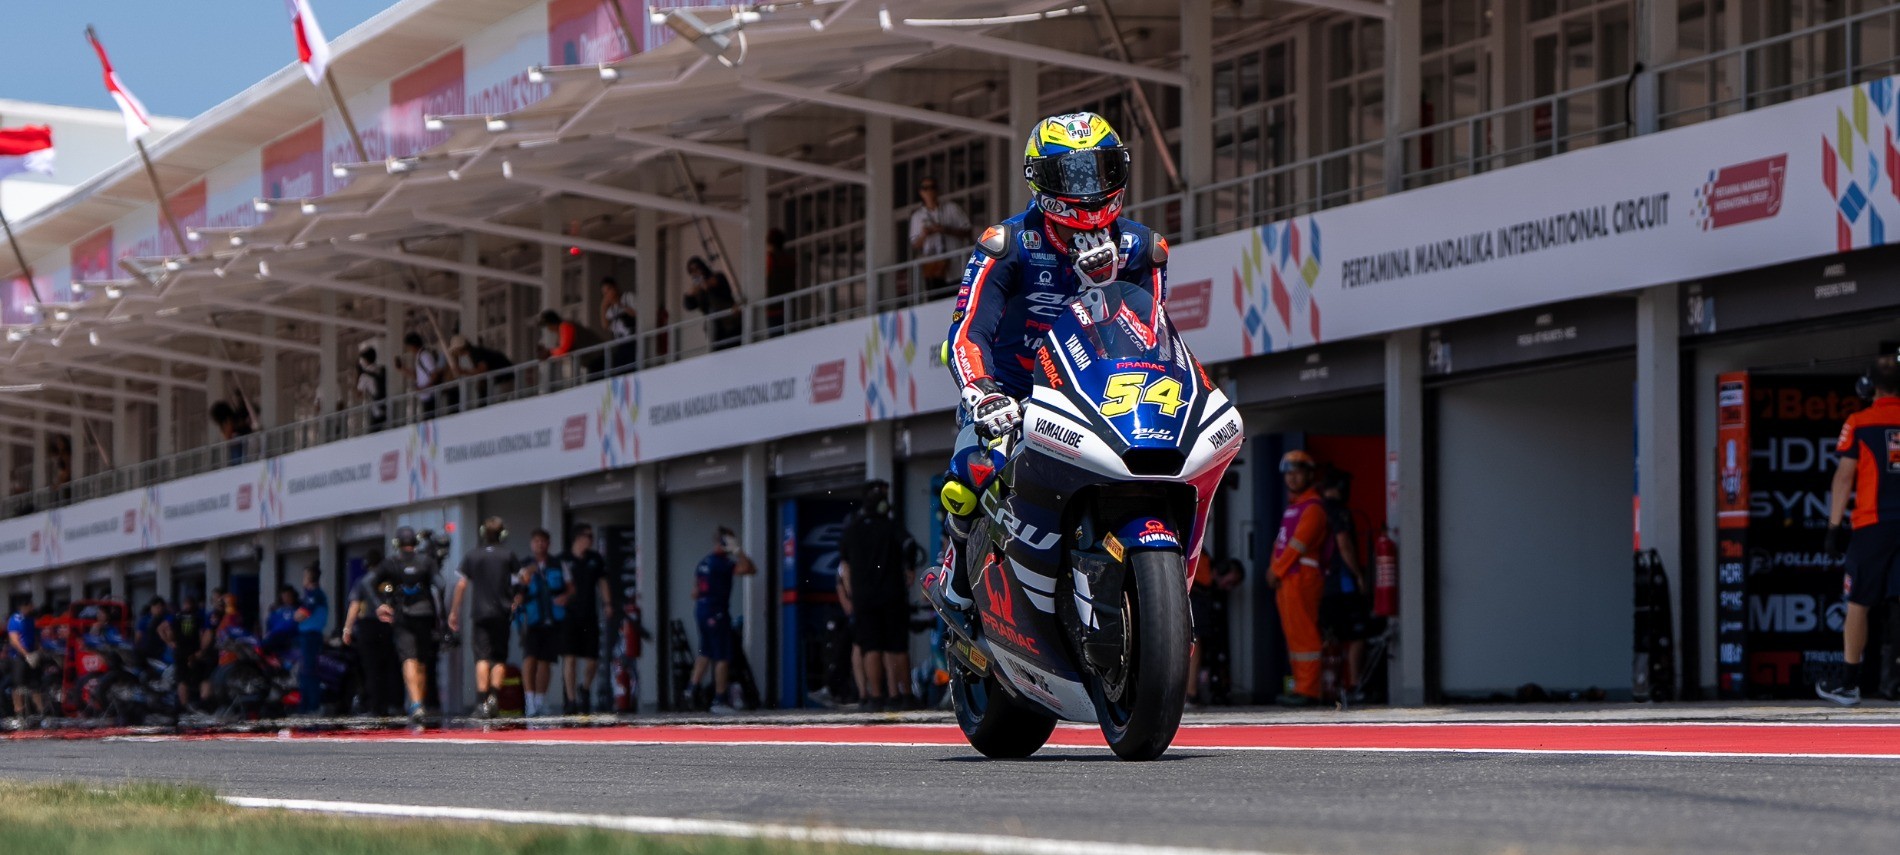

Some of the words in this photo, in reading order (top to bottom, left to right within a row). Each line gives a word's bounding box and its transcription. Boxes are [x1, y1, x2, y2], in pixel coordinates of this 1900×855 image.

[1341, 248, 1412, 290] PERTAMINA
[1413, 229, 1495, 276] MANDALIKA
[1497, 204, 1609, 259] INTERNATIONAL
[1612, 191, 1670, 235] CIRCUIT
[1071, 302, 1094, 326] WRS
[957, 345, 976, 381] PRAMAC
[1037, 345, 1064, 390] PRAMAC
[1065, 333, 1092, 372] YAMAHA
[1116, 362, 1167, 372] PRAMAC
[1099, 371, 1190, 418] 54
[1034, 417, 1084, 449] YAMALUBE
[1131, 427, 1172, 435] BLU
[1134, 433, 1175, 441] CRU
[1208, 420, 1239, 450] YAMALUBE
[980, 488, 1062, 550] CRU
[1138, 533, 1179, 545] YAMAHA
[981, 610, 1040, 655] PRAMAC
